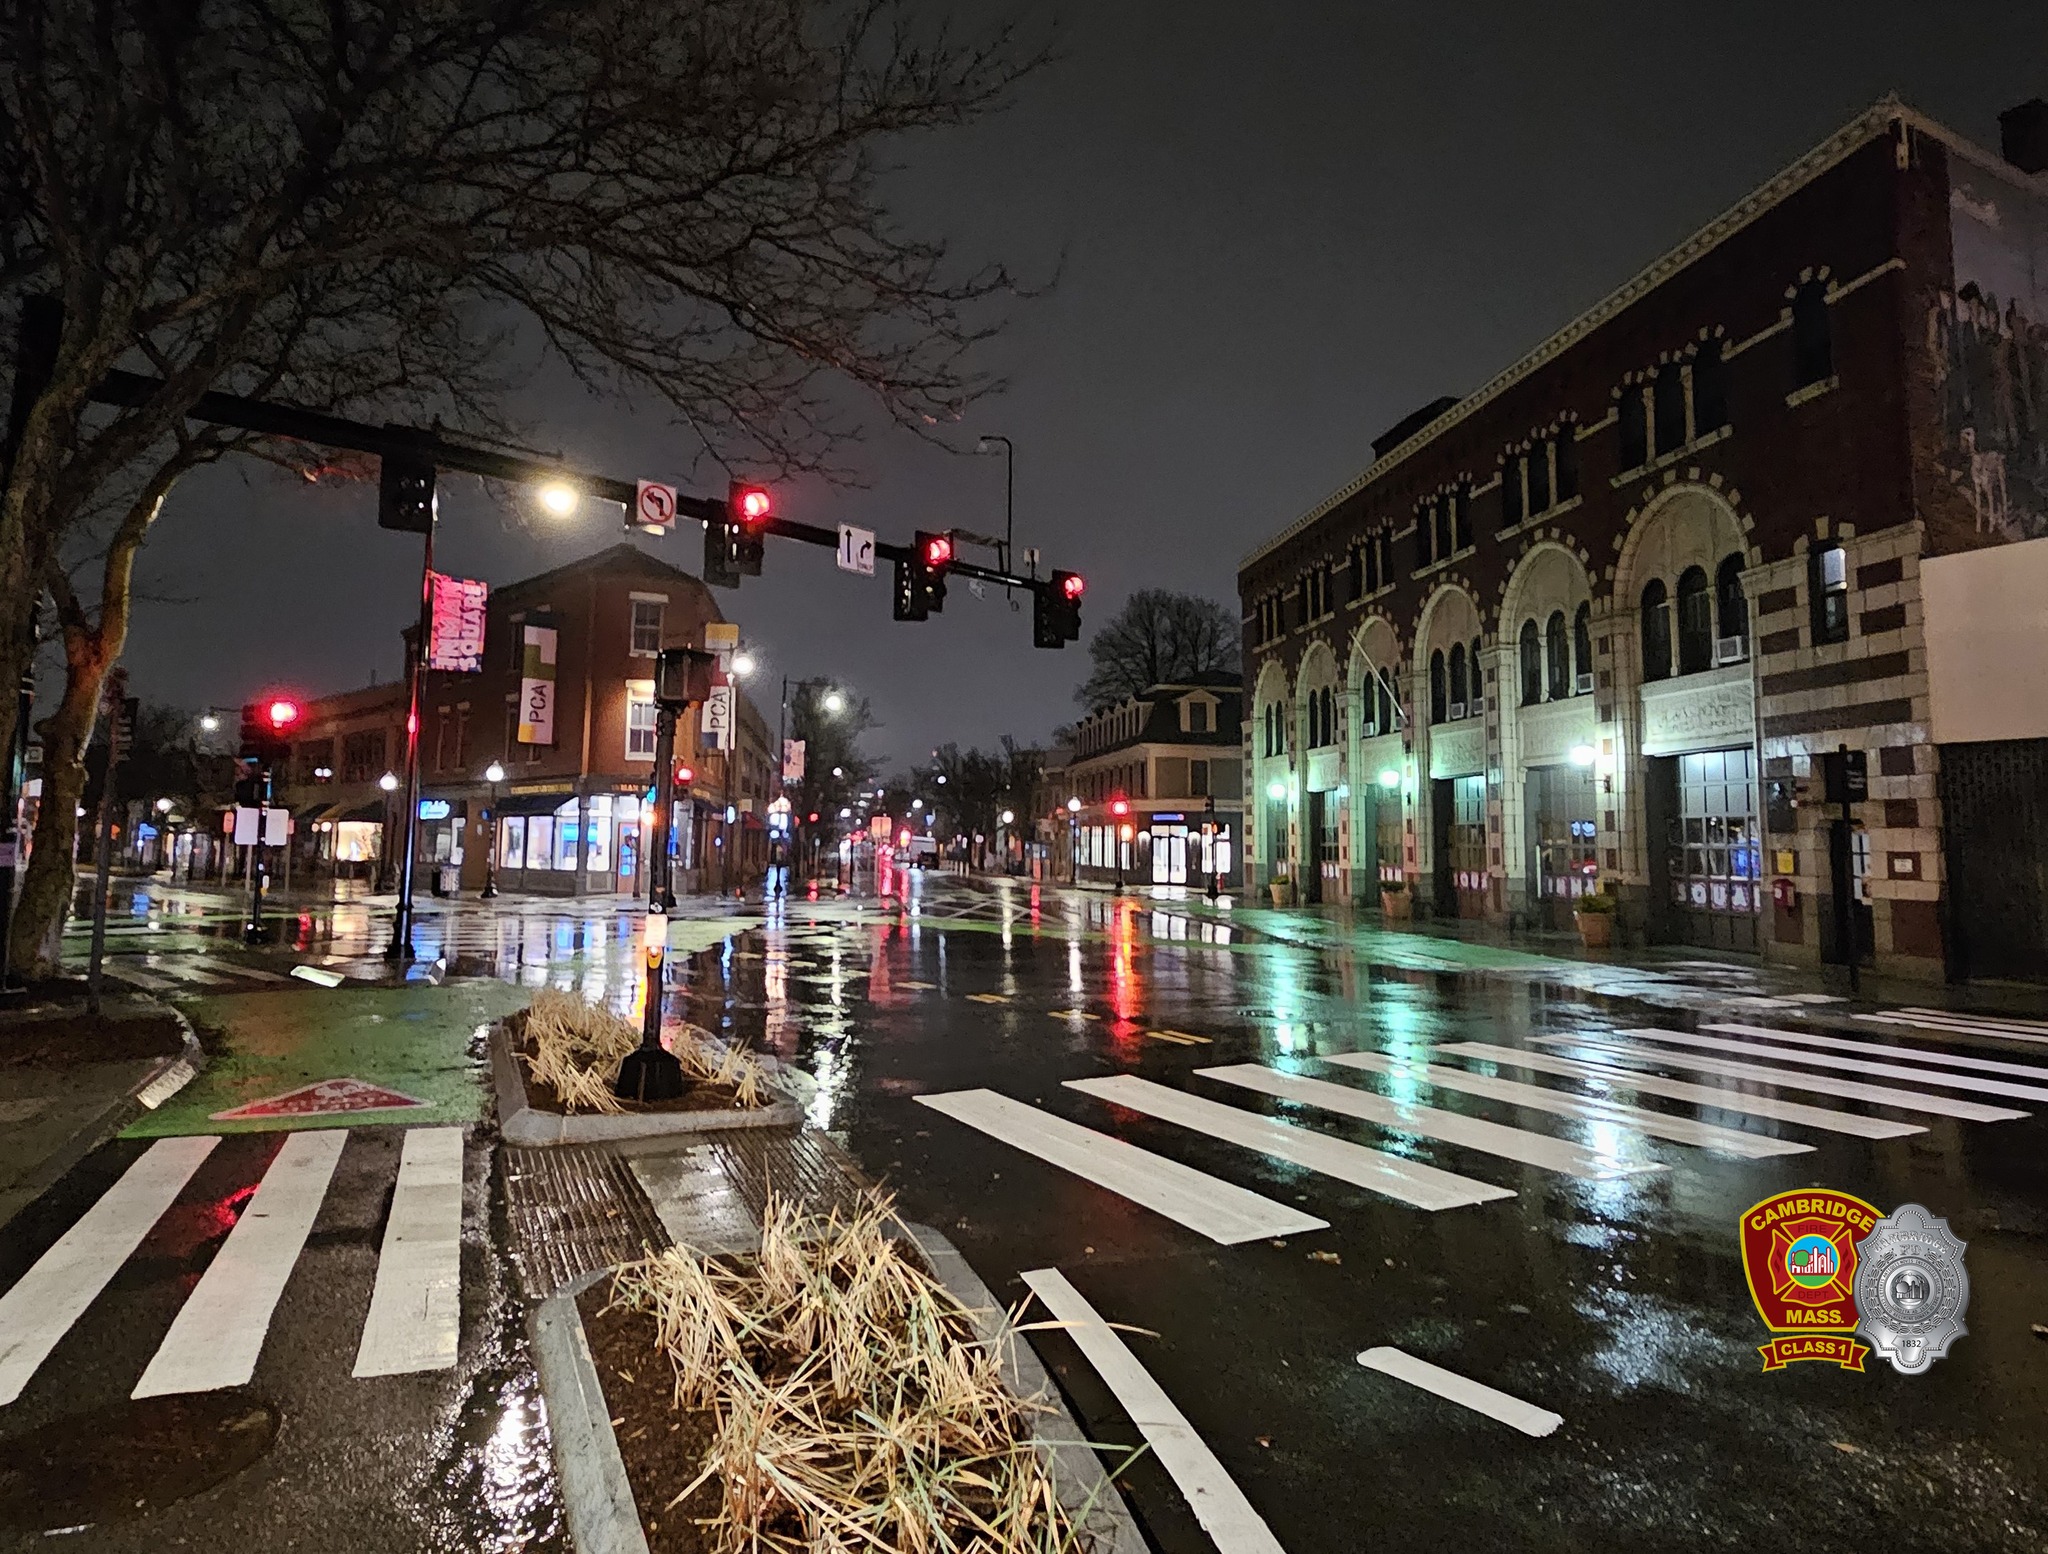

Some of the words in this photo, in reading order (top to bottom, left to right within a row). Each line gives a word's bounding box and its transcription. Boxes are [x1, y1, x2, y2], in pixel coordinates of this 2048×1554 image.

[459, 579, 482, 670] SQUARE
[528, 683, 548, 725] PCA
[710, 692, 727, 729] PCA
